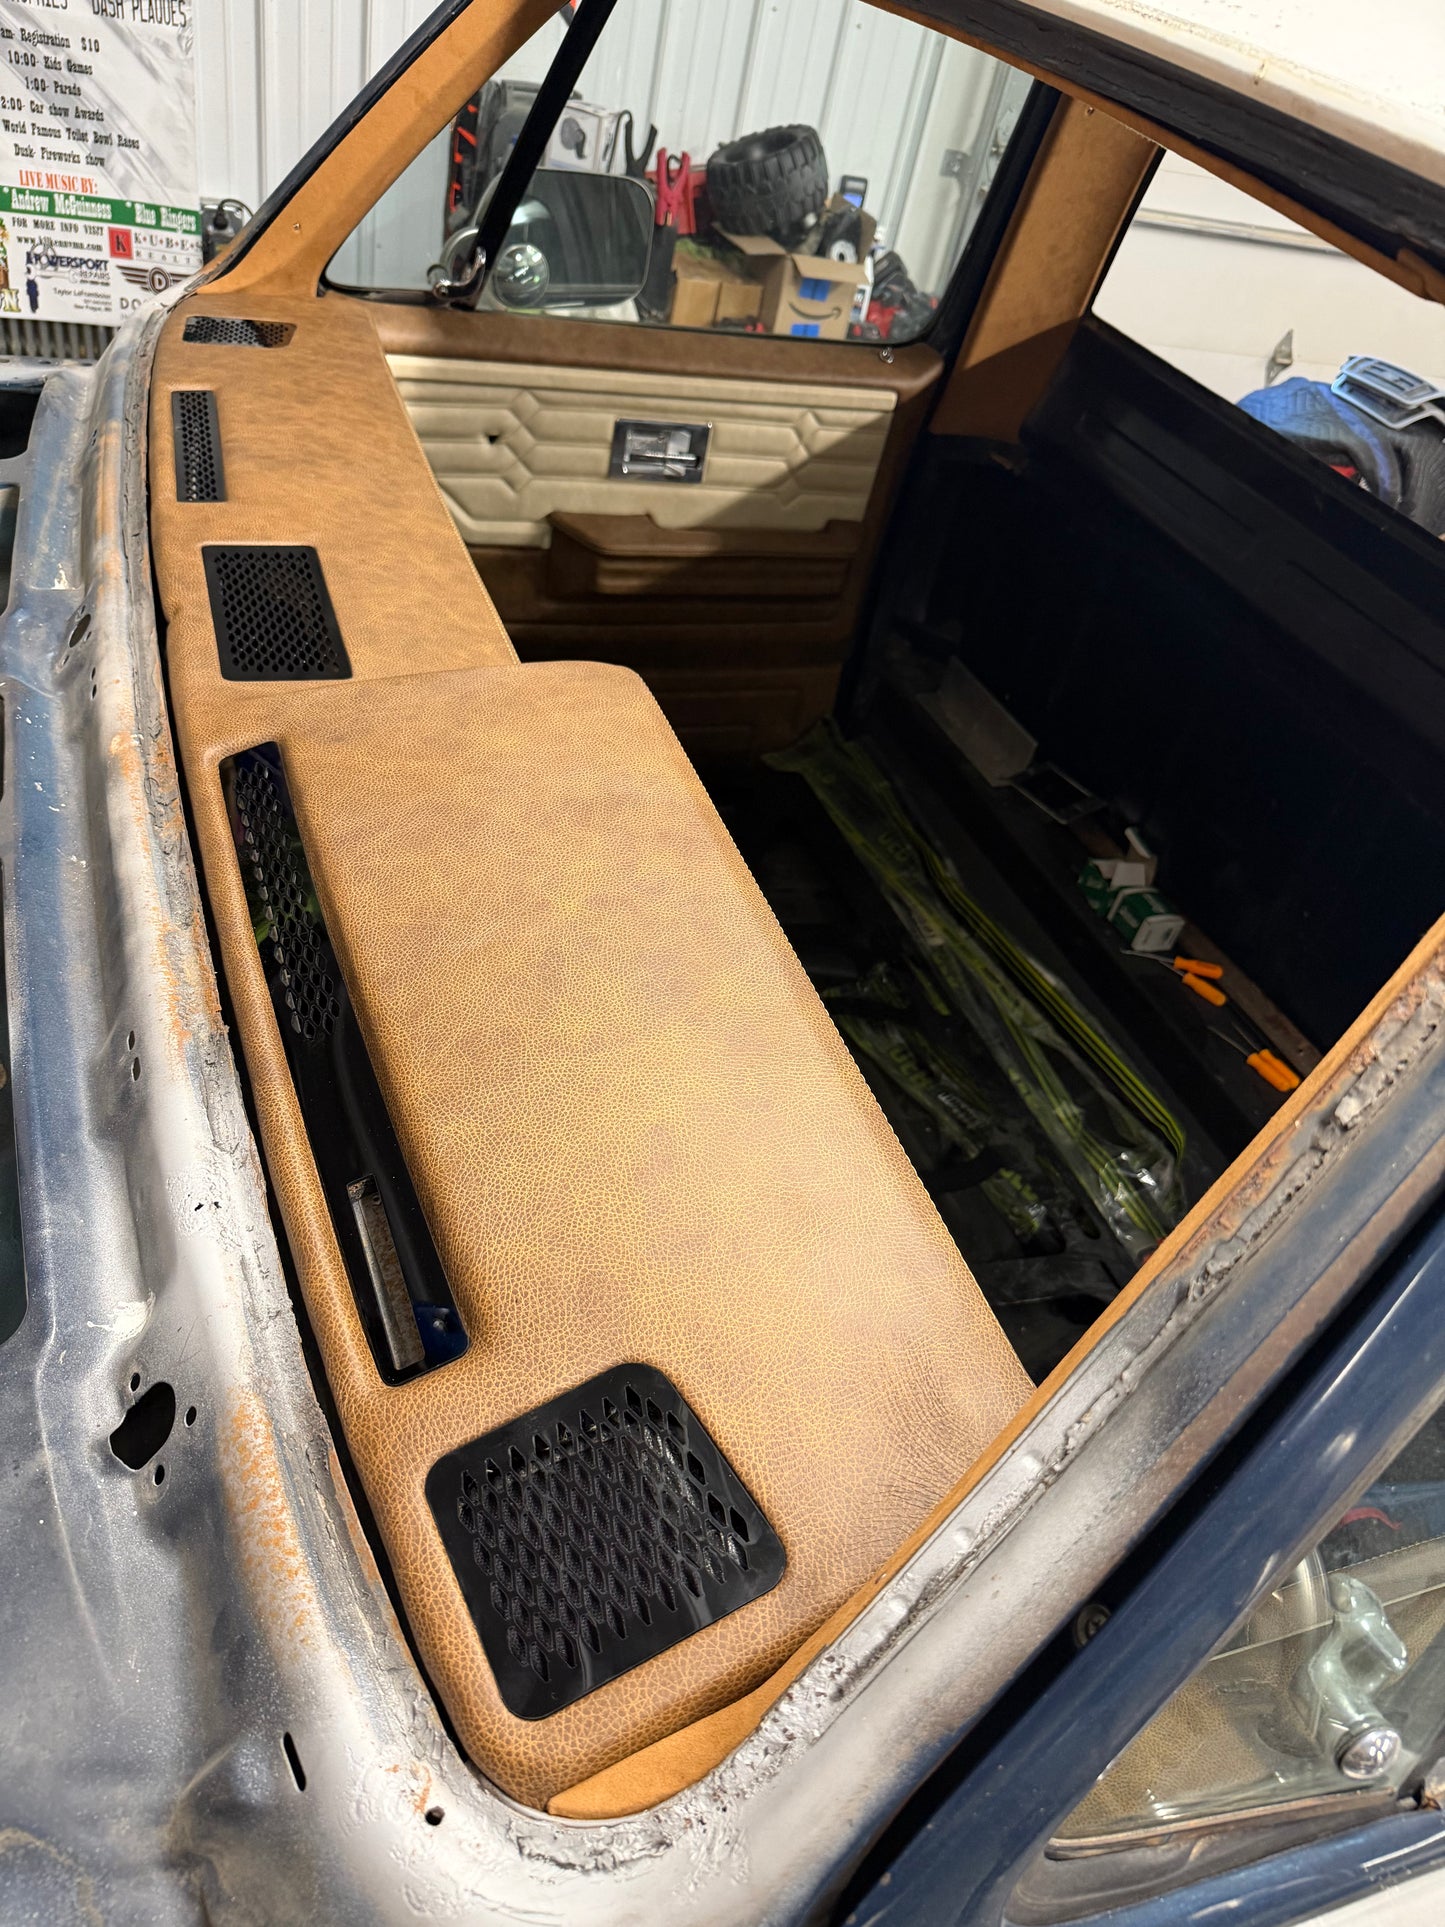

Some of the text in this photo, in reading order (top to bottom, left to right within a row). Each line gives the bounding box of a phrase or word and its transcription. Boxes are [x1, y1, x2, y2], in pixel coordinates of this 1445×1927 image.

[20, 28, 71, 48] Registration
[81, 38, 100, 52] $10
[8, 50, 93, 75] 10:00- Kids Games
[25, 76, 82, 97] 1:00- Parade
[29, 100, 44, 114] Car
[74, 106, 105, 121] Awards
[2, 119, 27, 134] World
[30, 123, 62, 139] Famous
[65, 127, 89, 142] Toilet
[93, 130, 113, 146] Bowl
[40, 147, 81, 164] Fireworks
[19, 169, 98, 194] LIVE MUSIC BY:
[11, 188, 49, 212] Andrew
[12, 216, 104, 236] FOR MORE INFO VISIT
[134, 203, 156, 226] Blue
